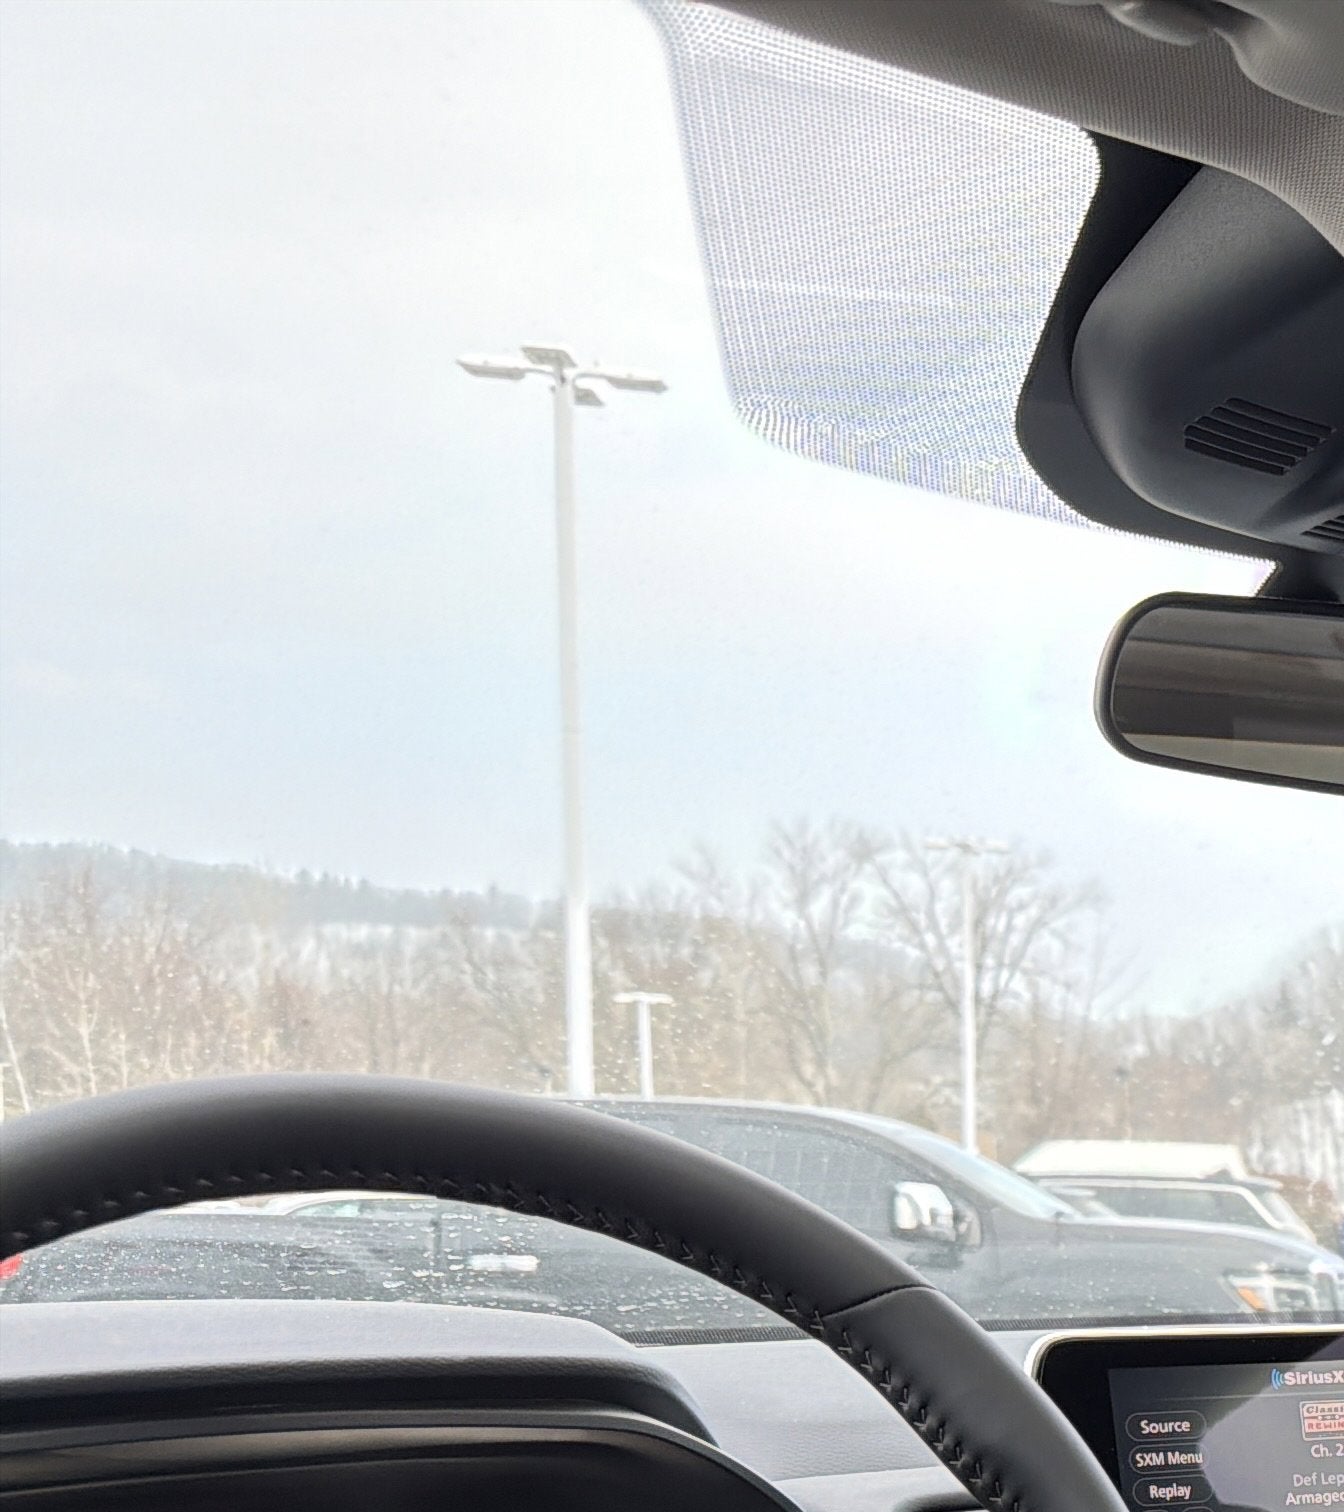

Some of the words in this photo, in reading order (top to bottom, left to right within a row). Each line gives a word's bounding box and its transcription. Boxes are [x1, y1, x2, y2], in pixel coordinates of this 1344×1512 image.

[1140, 1419, 1191, 1434] Source
[1310, 1444, 1332, 1458] Ch.
[1135, 1453, 1165, 1468] SXM
[1167, 1452, 1203, 1465] Menu
[1292, 1474, 1317, 1487] Def
[1149, 1484, 1191, 1501] Replay
